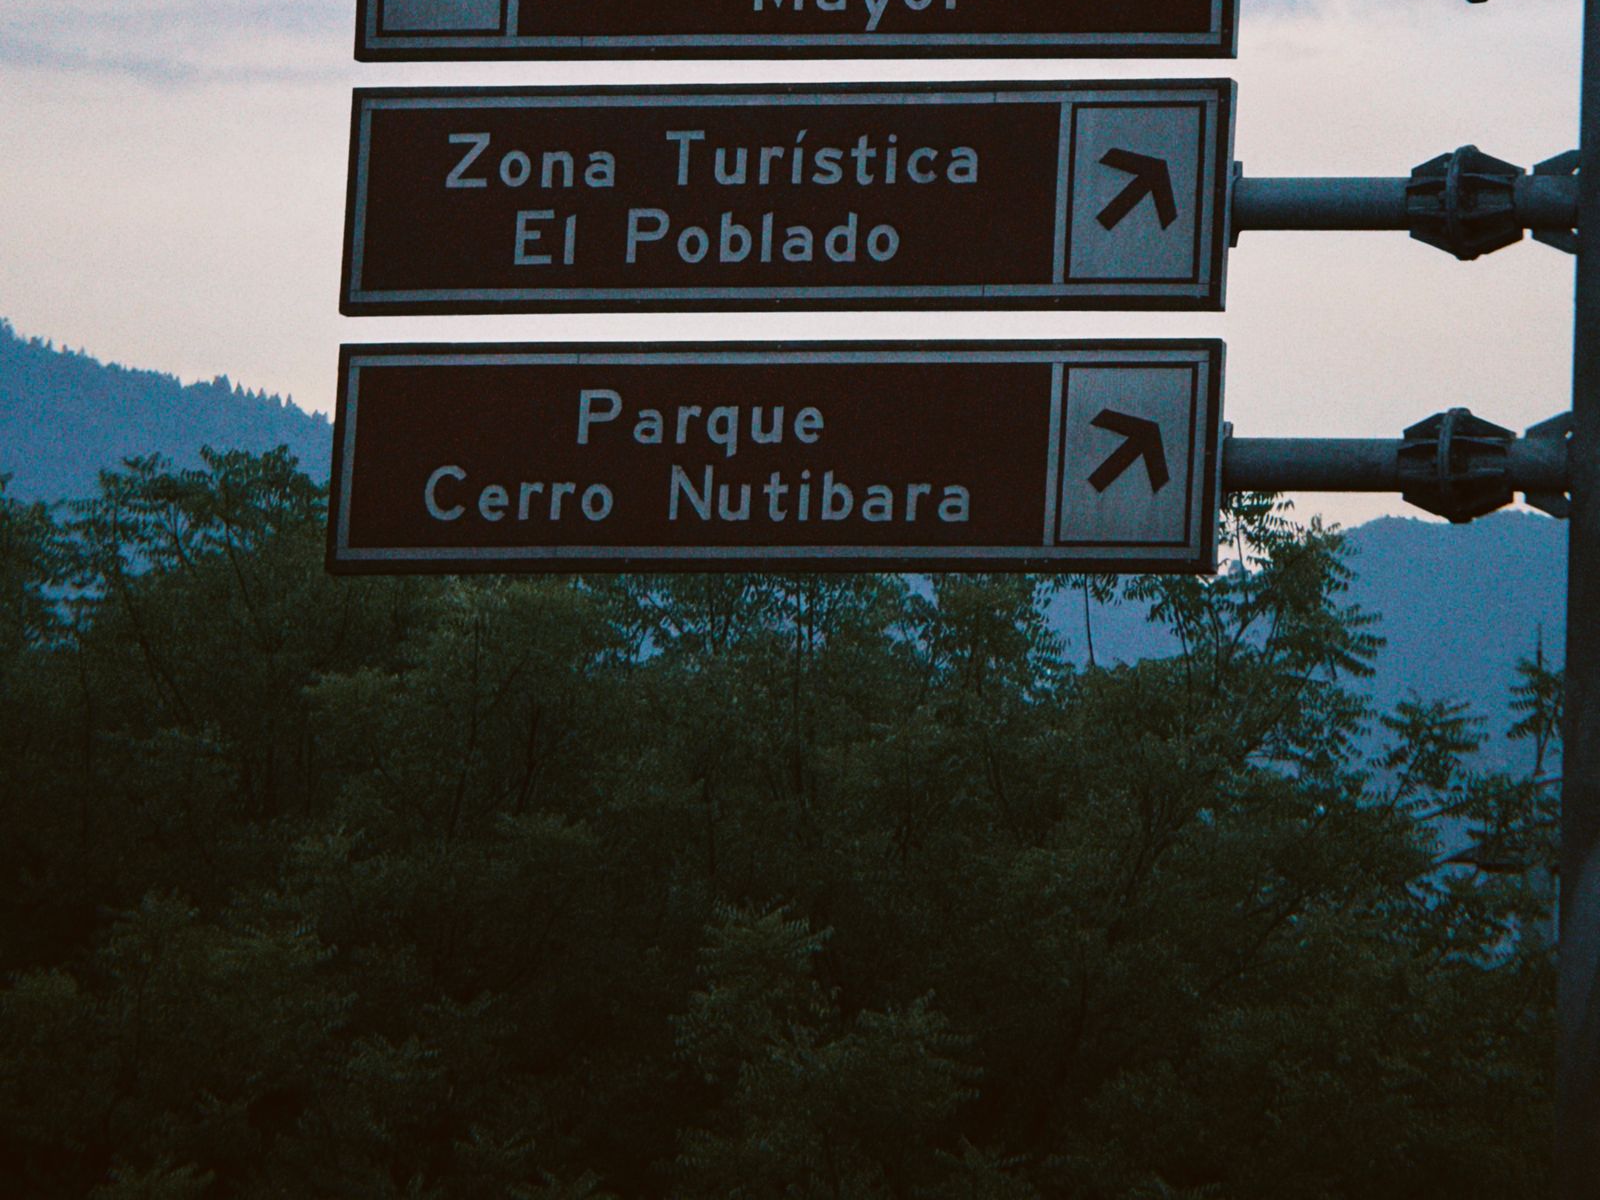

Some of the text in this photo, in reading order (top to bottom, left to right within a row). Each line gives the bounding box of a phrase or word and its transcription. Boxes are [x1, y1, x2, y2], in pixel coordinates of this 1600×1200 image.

[445, 129, 979, 188] Zona Turística
[513, 208, 901, 266] El Poblado
[577, 388, 826, 458] Parque
[424, 464, 971, 523] Cerro Nutibara
